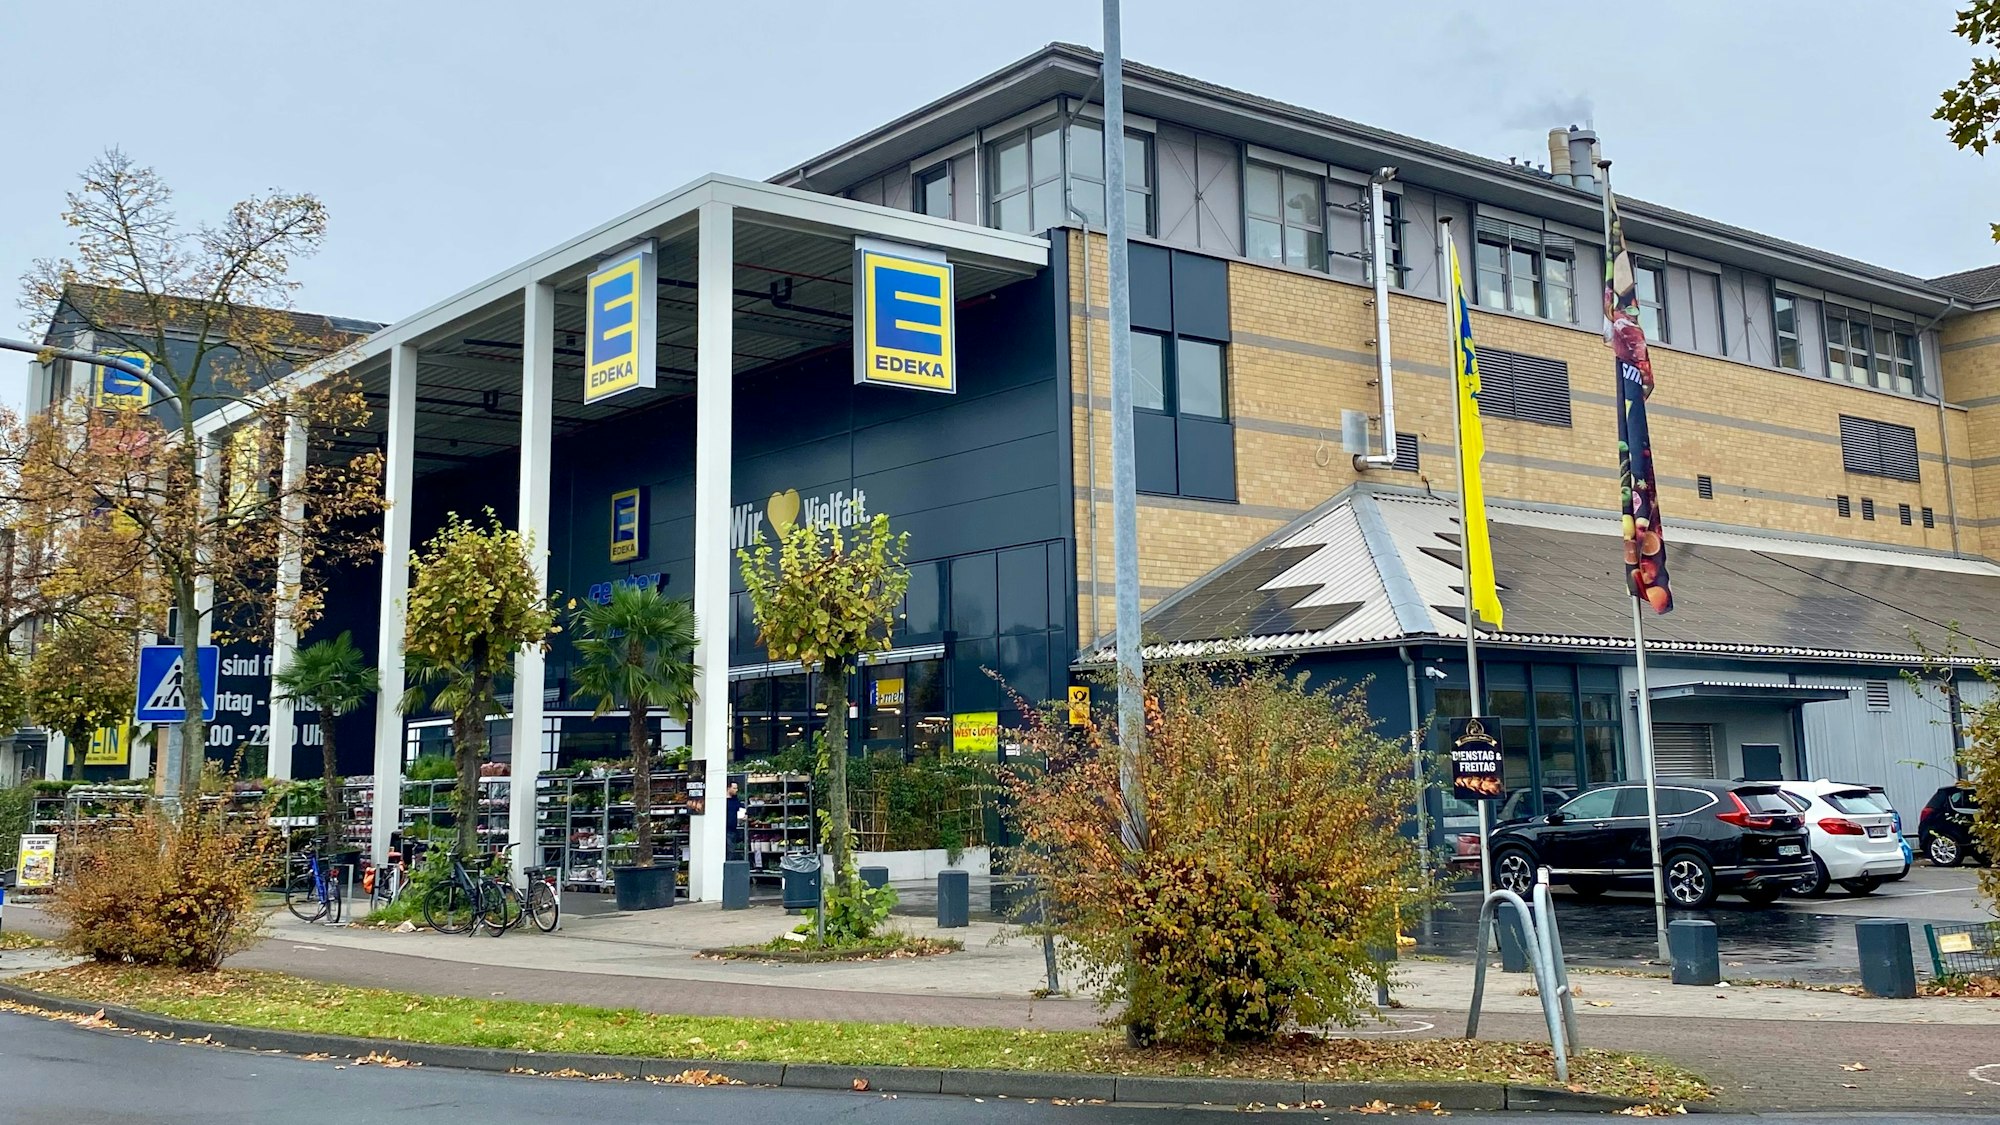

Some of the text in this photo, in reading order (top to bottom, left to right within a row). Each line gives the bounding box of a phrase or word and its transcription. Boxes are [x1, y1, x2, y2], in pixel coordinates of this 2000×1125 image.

[592, 271, 633, 366] E
[874, 266, 942, 356] E
[591, 361, 633, 388] EDEKA
[875, 354, 945, 378] EDEKA
[730, 502, 763, 550] Wir
[612, 543, 635, 556] EDEKA
[221, 654, 260, 676] sind
[215, 691, 253, 716] ntag
[302, 724, 323, 746] Uh
[1451, 750, 1494, 761] DIENSTAG
[1459, 762, 1496, 772] FREITAG
